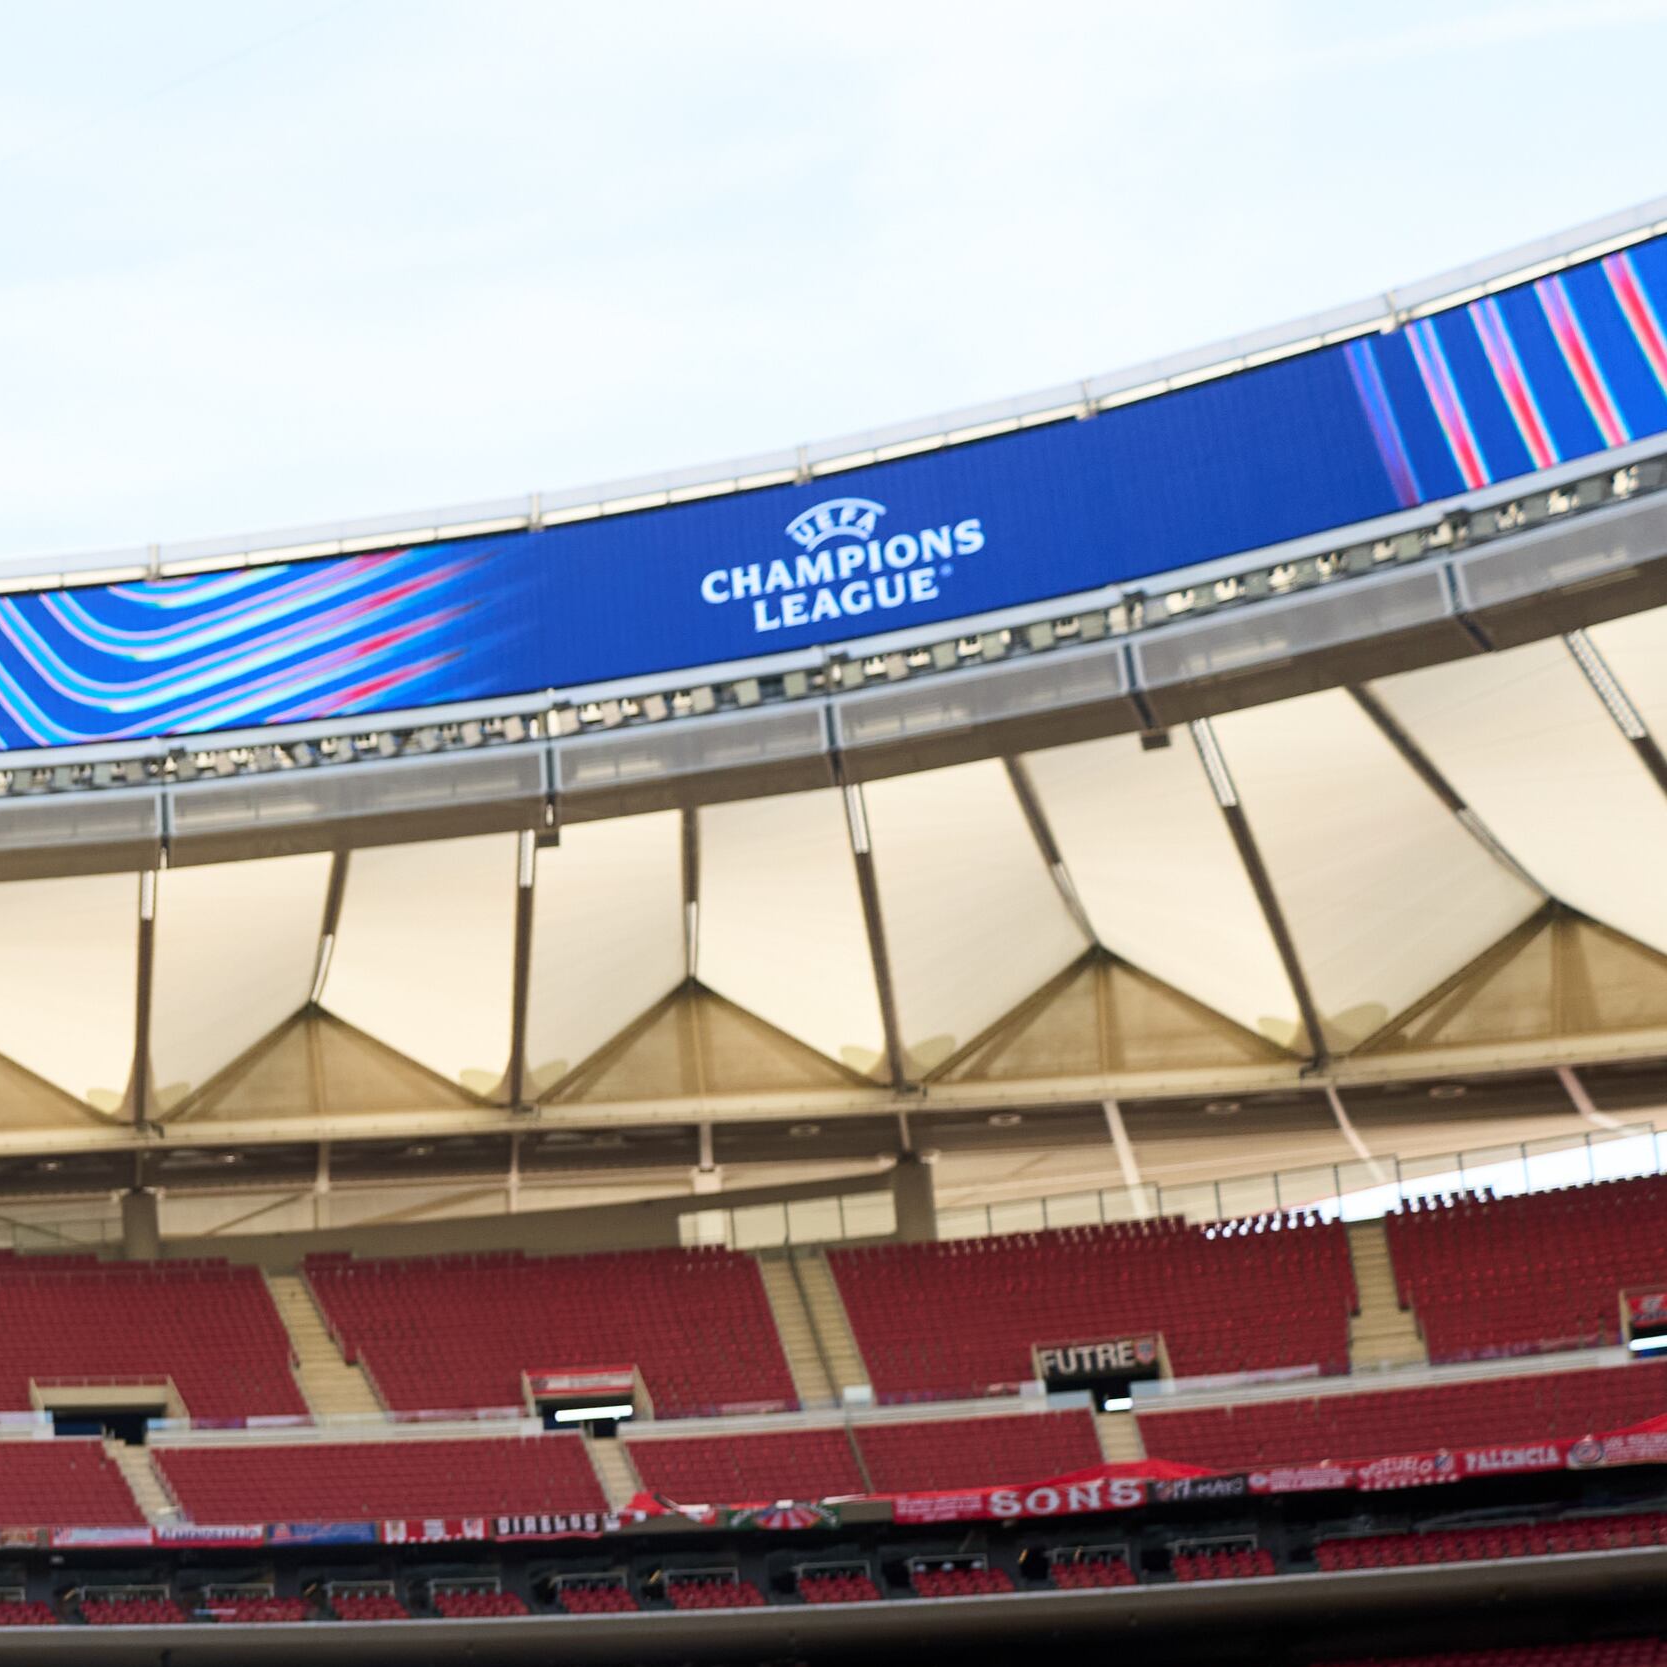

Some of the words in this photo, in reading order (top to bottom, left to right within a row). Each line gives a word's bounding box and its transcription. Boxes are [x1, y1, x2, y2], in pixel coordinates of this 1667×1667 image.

[790, 505, 879, 547] UEFA
[700, 517, 986, 605] CHAMPIONS
[753, 566, 940, 634] LEAGUE
[1038, 1340, 1136, 1376] FUTRE
[1463, 1445, 1560, 1473] PALENCIA
[989, 1478, 1143, 1518] SONS
